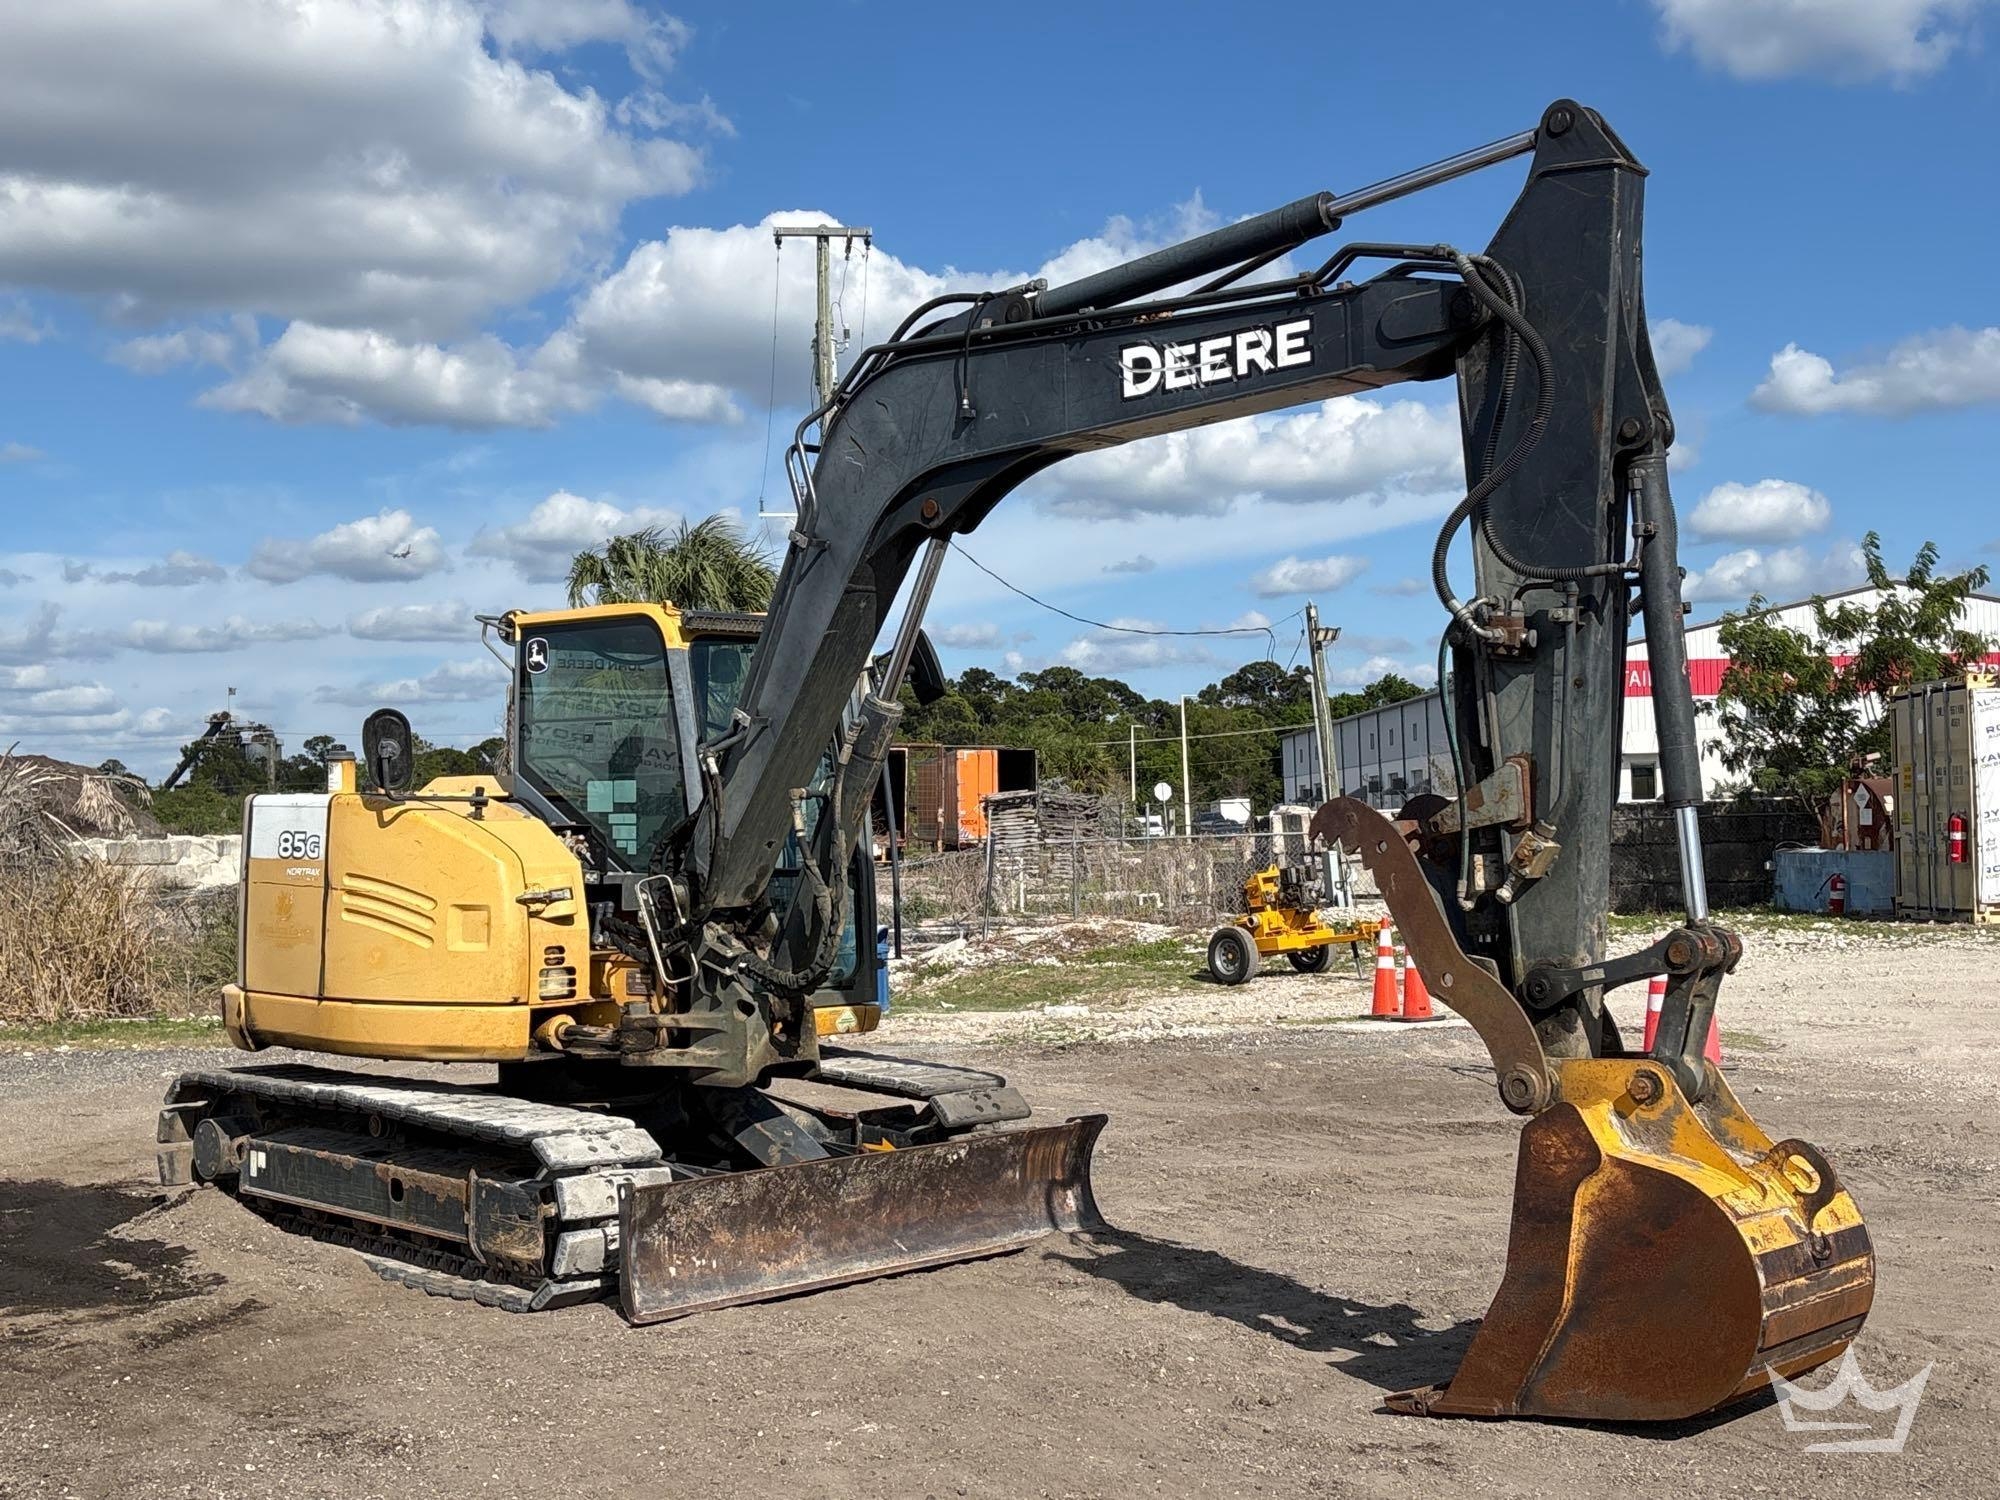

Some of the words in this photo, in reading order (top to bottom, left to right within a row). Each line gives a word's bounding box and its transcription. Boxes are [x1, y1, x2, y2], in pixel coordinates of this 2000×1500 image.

[1121, 319, 1312, 398] DEERE
[278, 830, 320, 860] 85G
[286, 867, 320, 876] NORTRAX
